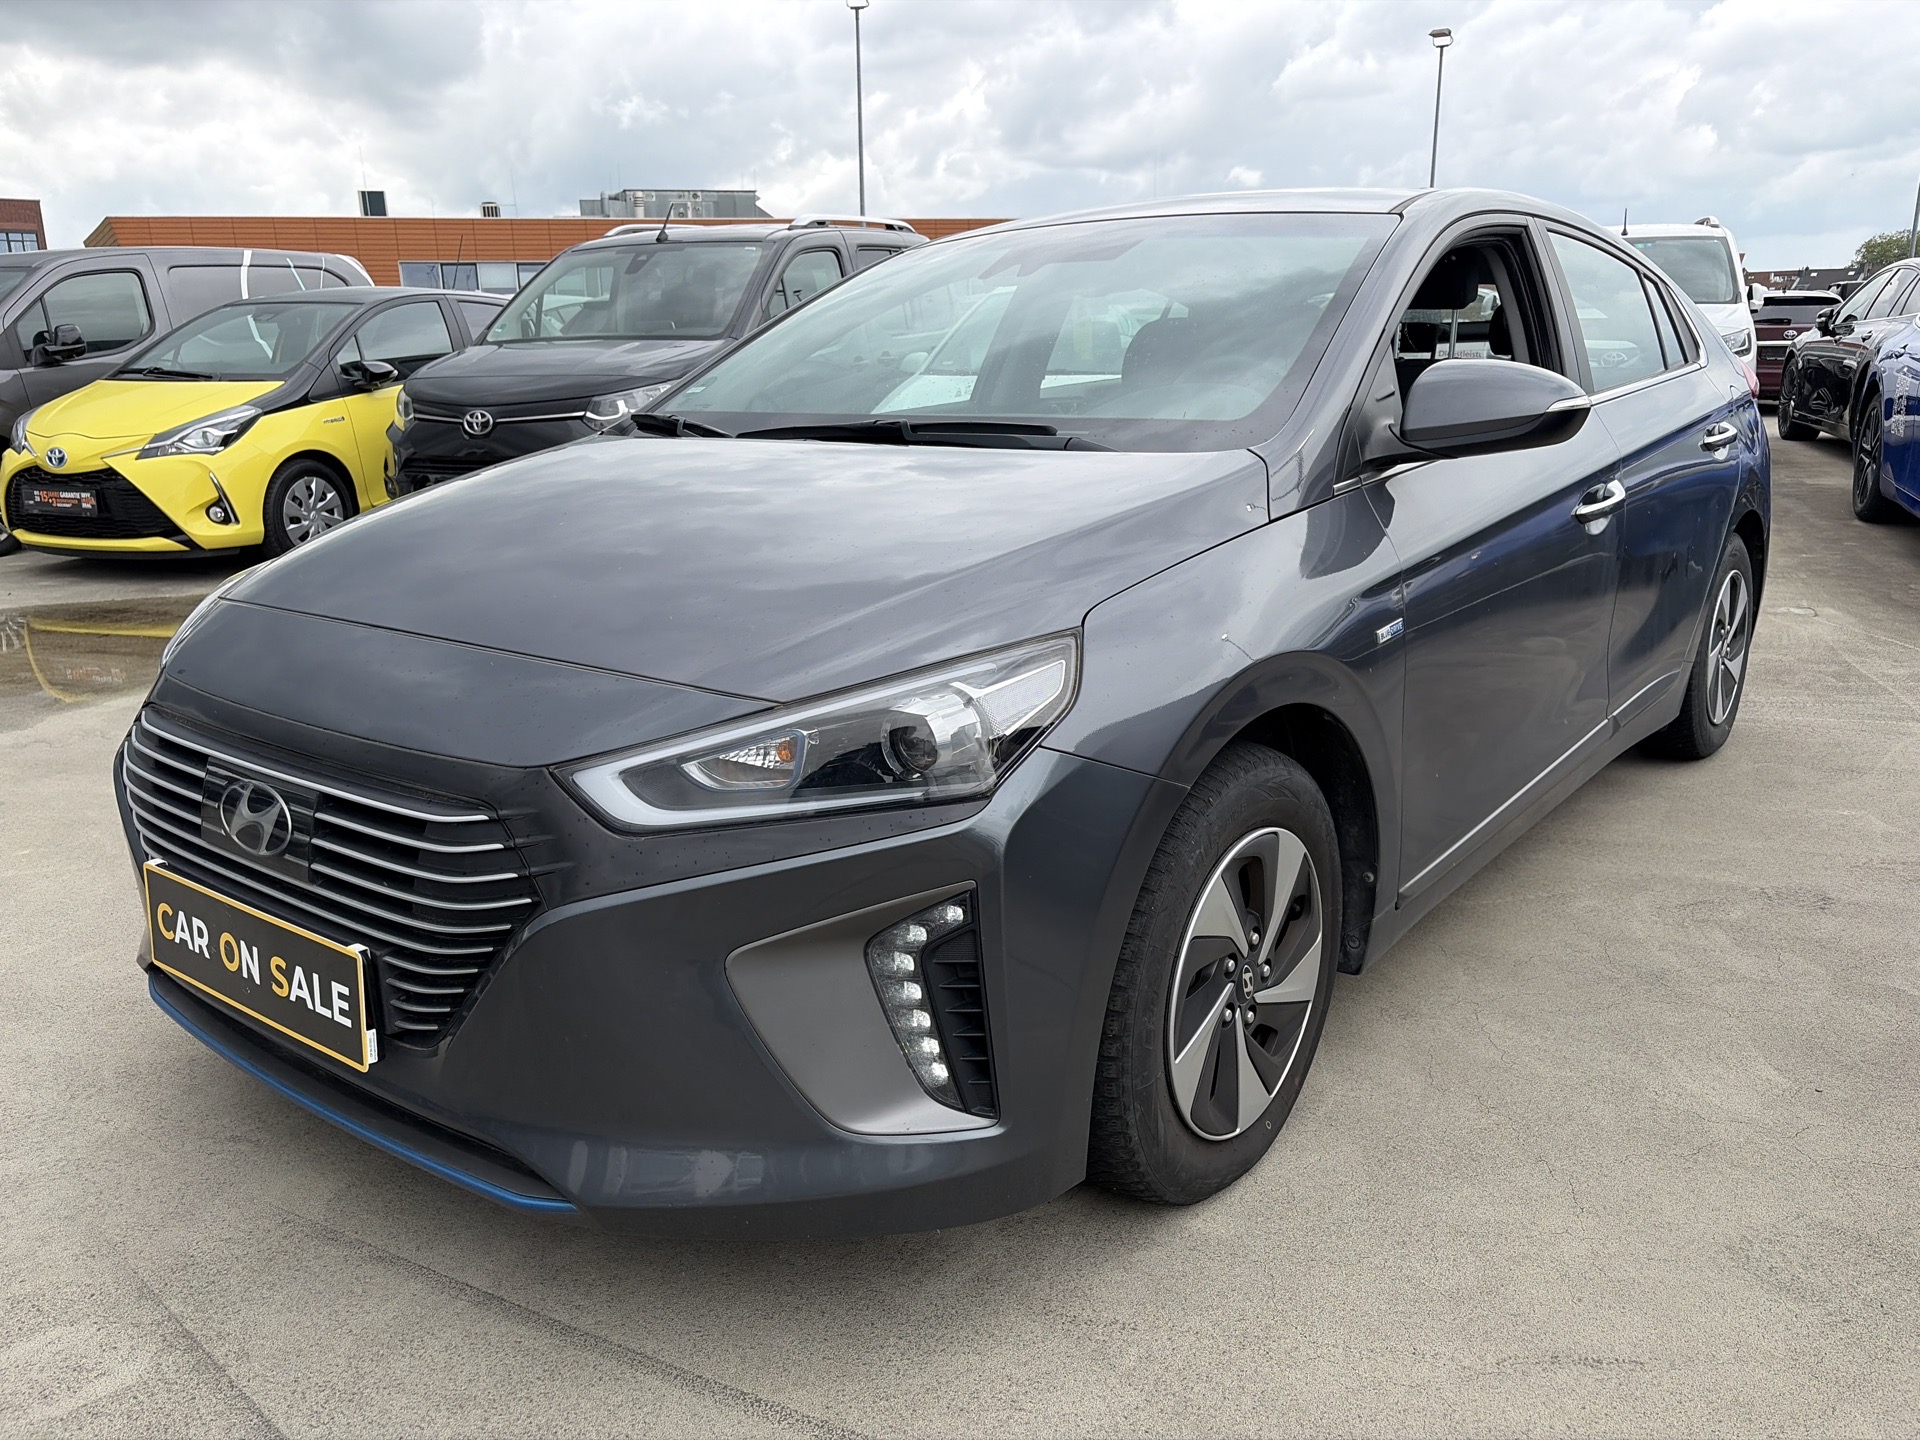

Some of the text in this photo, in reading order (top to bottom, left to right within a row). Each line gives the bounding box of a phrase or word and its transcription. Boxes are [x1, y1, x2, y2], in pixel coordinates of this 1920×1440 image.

[60, 491, 80, 499] GARANTIE
[157, 902, 352, 1028] CAR ON SALE
